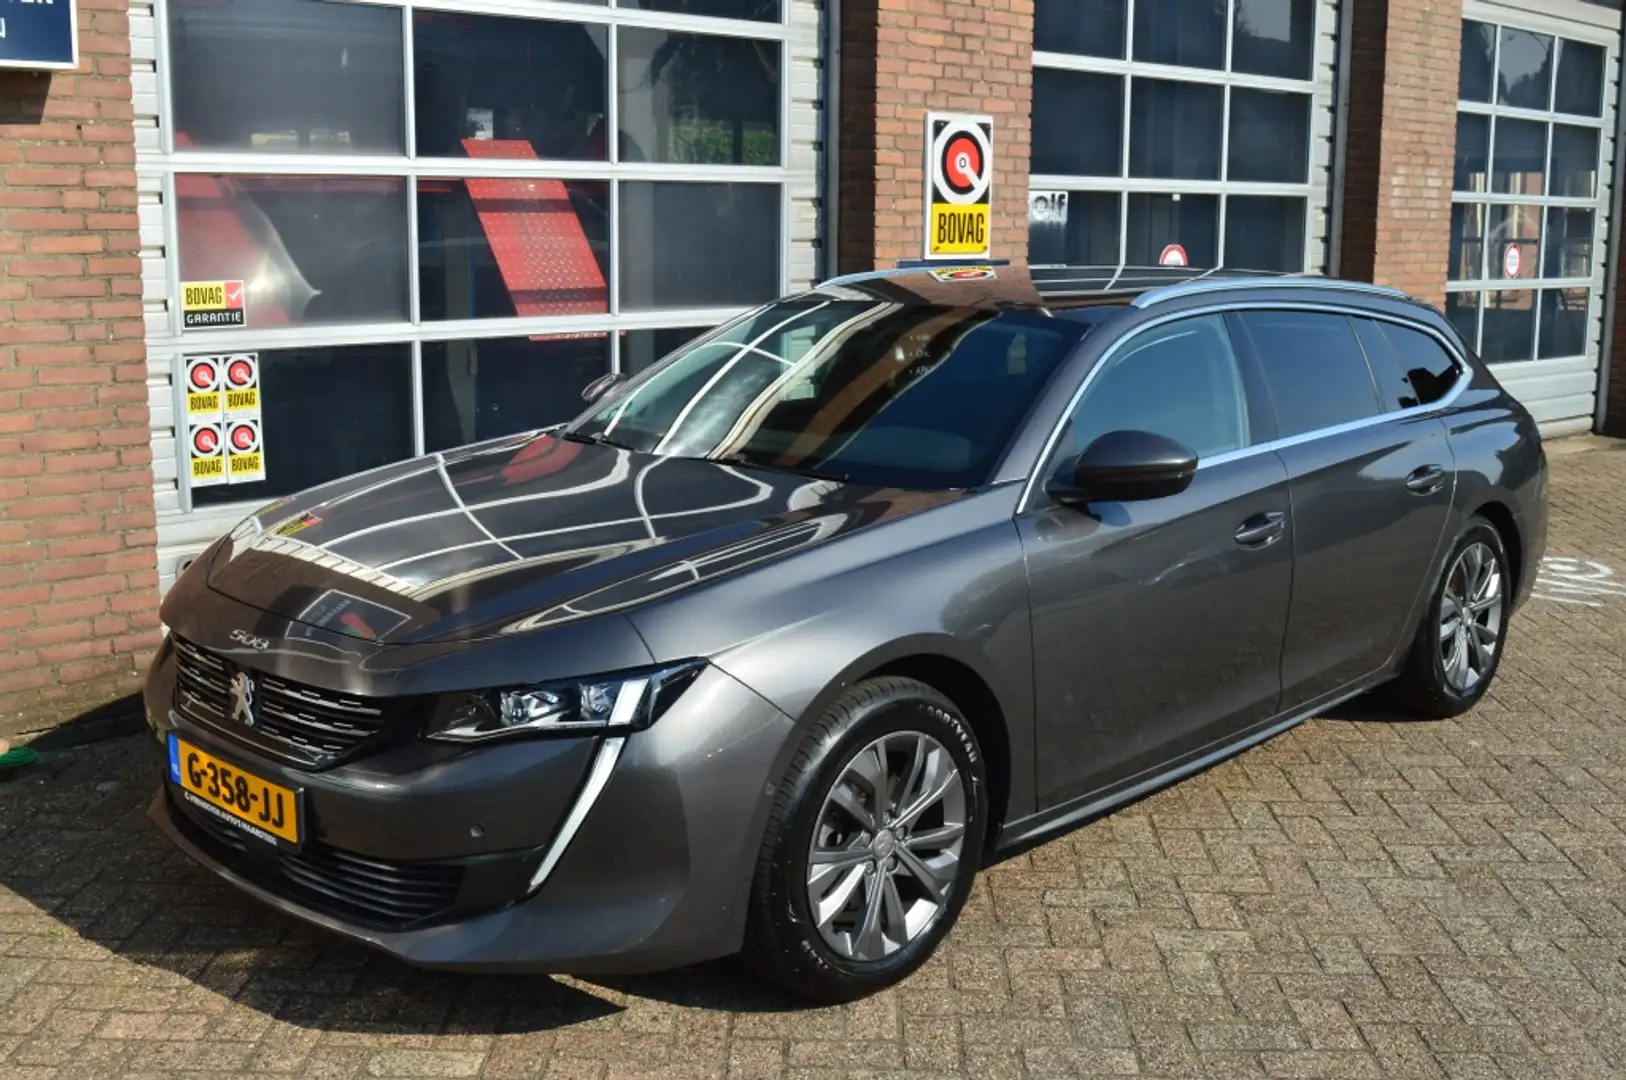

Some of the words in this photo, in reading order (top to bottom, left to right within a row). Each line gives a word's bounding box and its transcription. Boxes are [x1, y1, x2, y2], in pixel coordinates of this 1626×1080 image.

[938, 213, 985, 245] BOVAG
[185, 287, 222, 305] BOVAG
[186, 312, 242, 324] GARANTIE
[190, 395, 219, 411] BOVAG
[227, 391, 256, 408] BOVAG
[193, 459, 222, 476] BOVAG
[231, 455, 260, 472] BOVAG
[229, 629, 270, 650] 508
[187, 752, 284, 829] G-358-JJ
